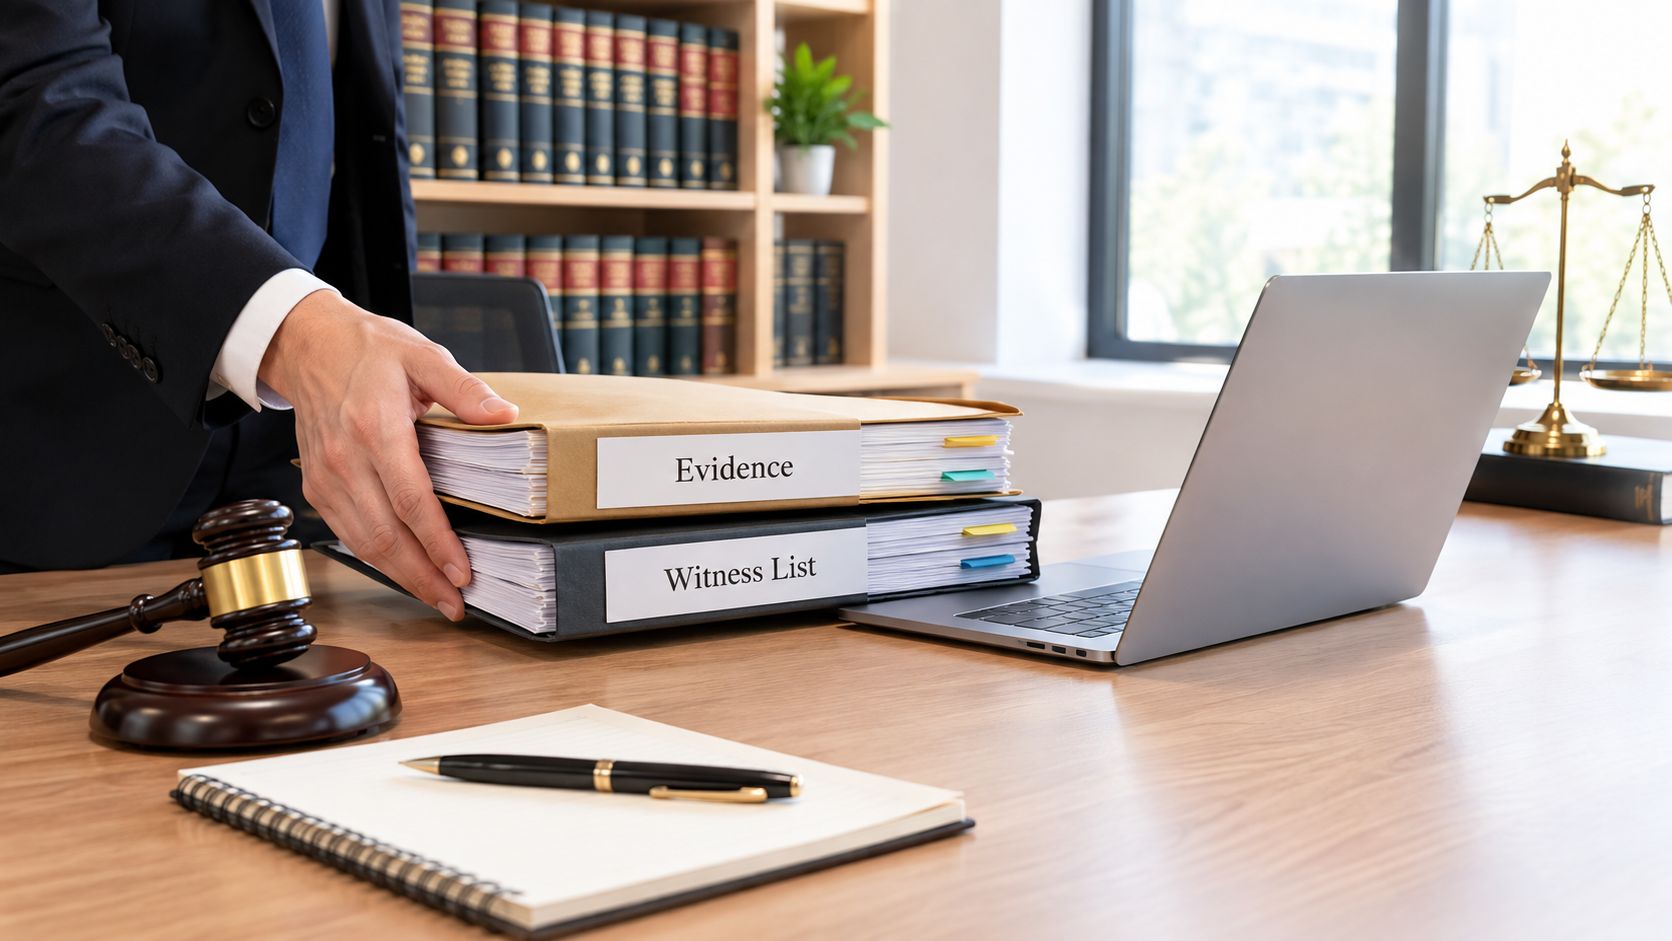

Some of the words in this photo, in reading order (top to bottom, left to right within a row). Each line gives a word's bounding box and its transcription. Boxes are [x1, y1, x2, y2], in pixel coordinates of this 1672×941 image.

[675, 455, 794, 483] Evidence
[664, 566, 764, 591] Witness
[771, 555, 817, 581] List
